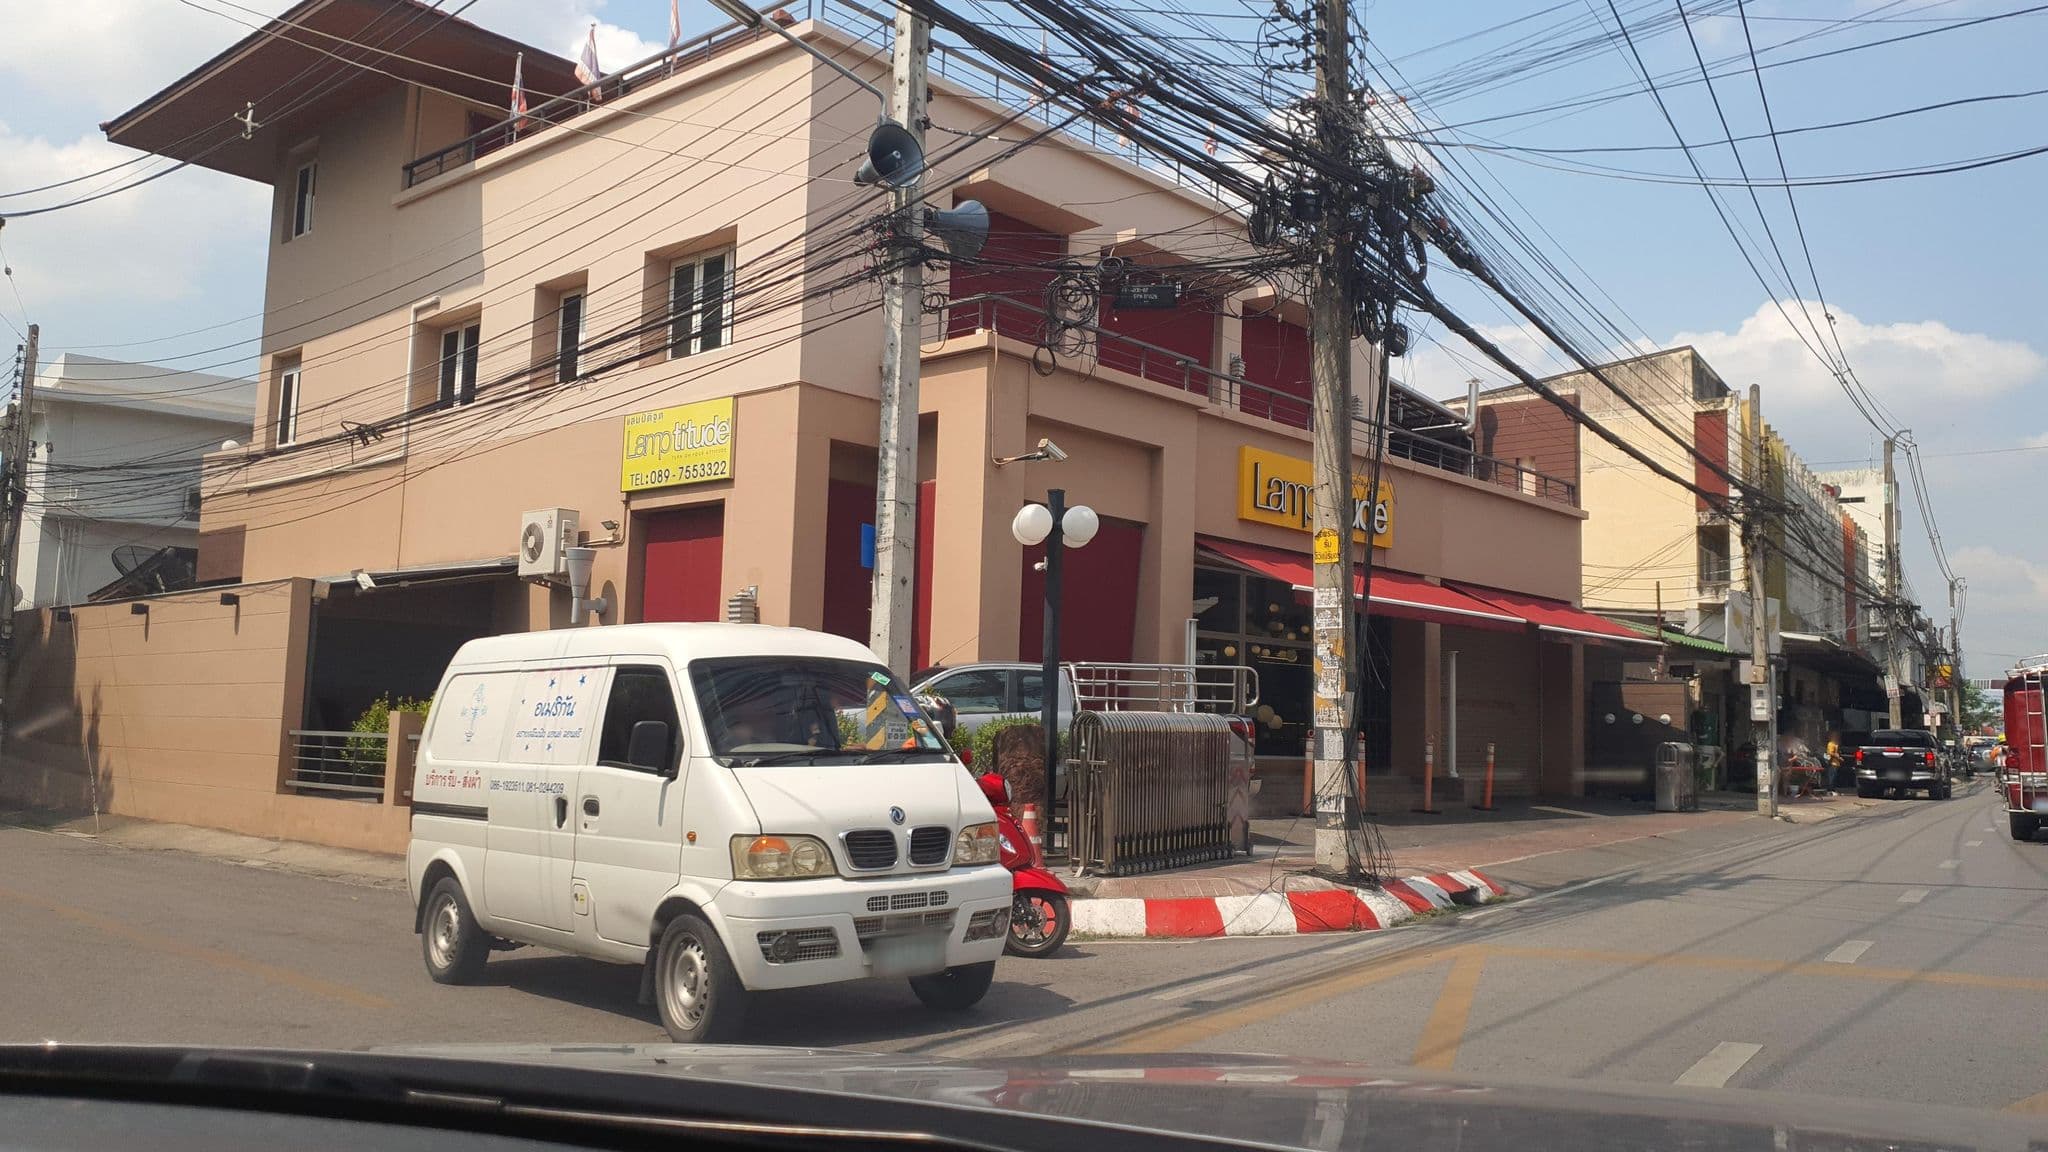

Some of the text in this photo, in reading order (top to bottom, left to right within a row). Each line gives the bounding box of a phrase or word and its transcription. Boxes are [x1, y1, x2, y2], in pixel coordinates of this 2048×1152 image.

[626, 415, 731, 460] Lamptitude
[534, 695, 577, 717] อเมริกัน
